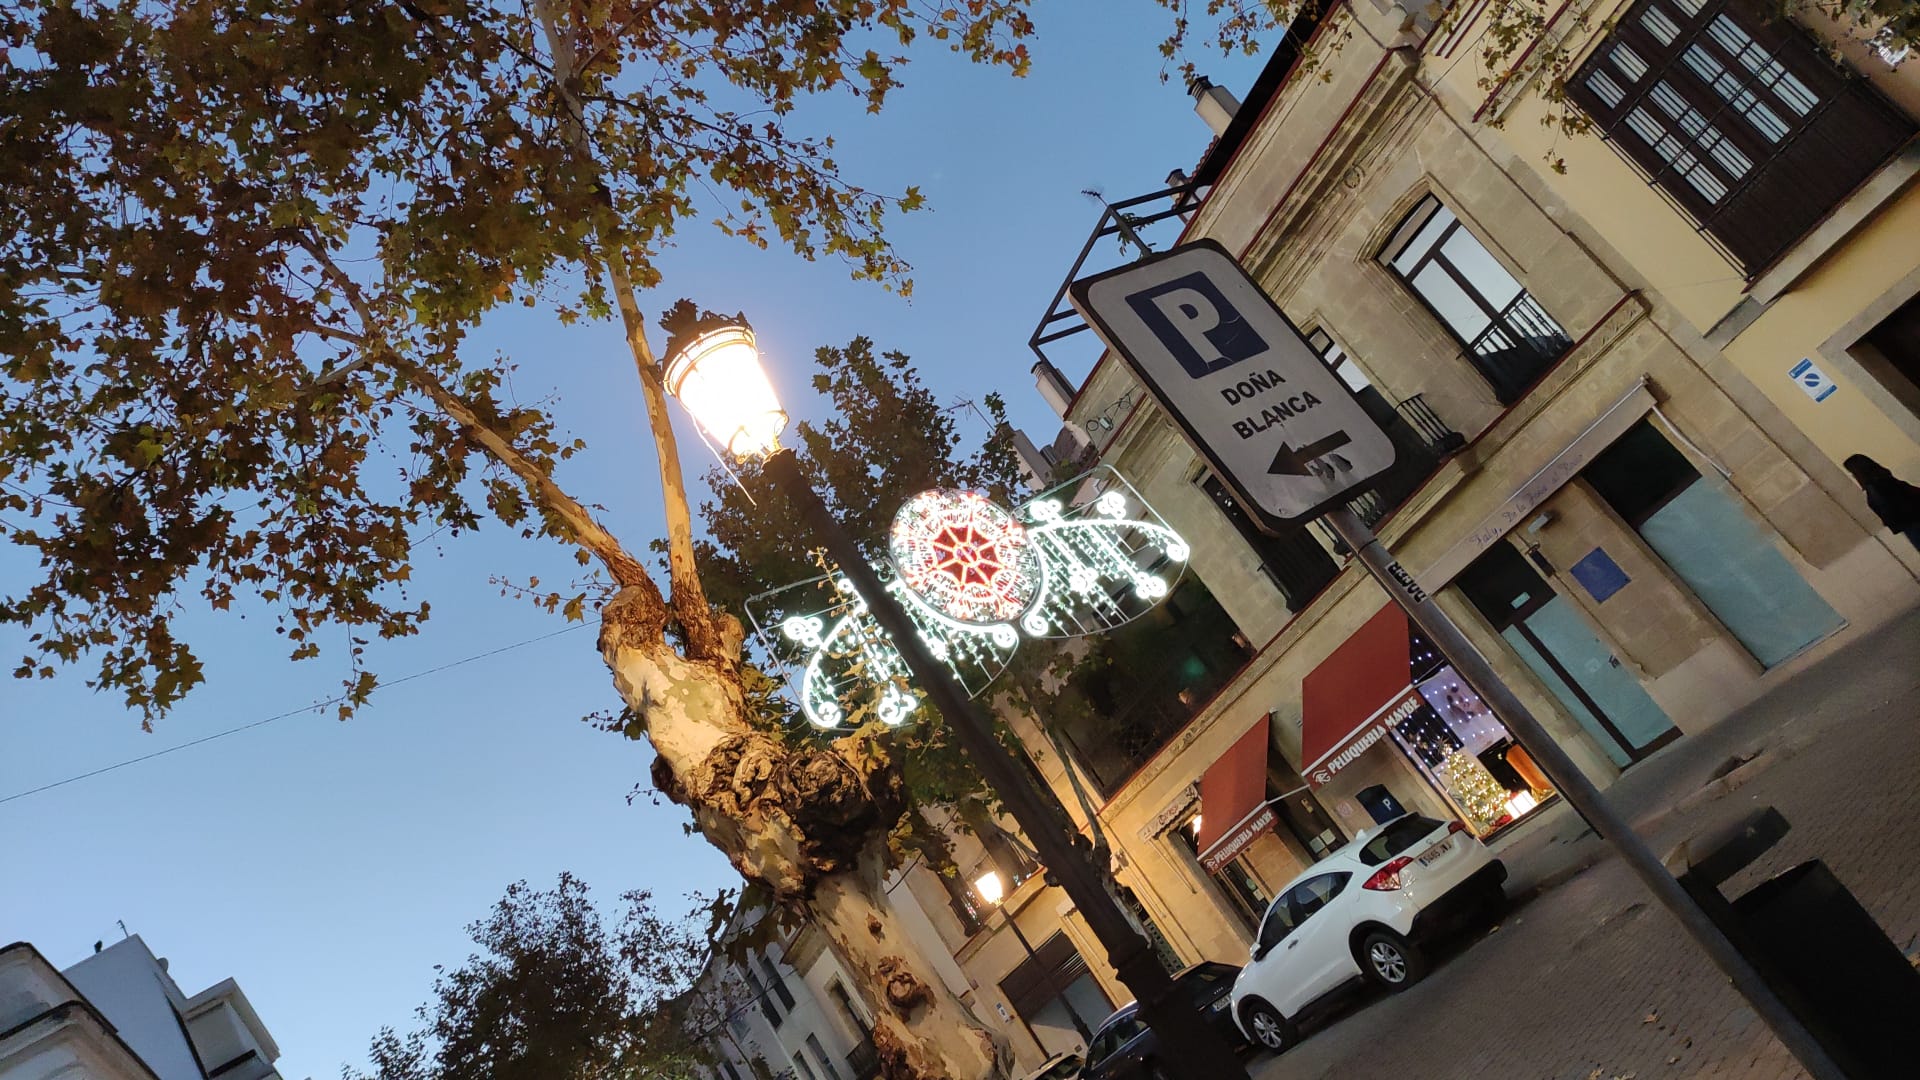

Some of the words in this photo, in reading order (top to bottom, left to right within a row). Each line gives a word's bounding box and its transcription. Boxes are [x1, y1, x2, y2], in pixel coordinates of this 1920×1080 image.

[1150, 288, 1222, 364] P
[1221, 369, 1286, 407] DOÑA
[1232, 391, 1322, 440] BLANCA
[1327, 724, 1387, 774] PELUQUERIA
[1384, 696, 1420, 730] MAYBE
[1214, 828, 1253, 863] PELUQUERIA
